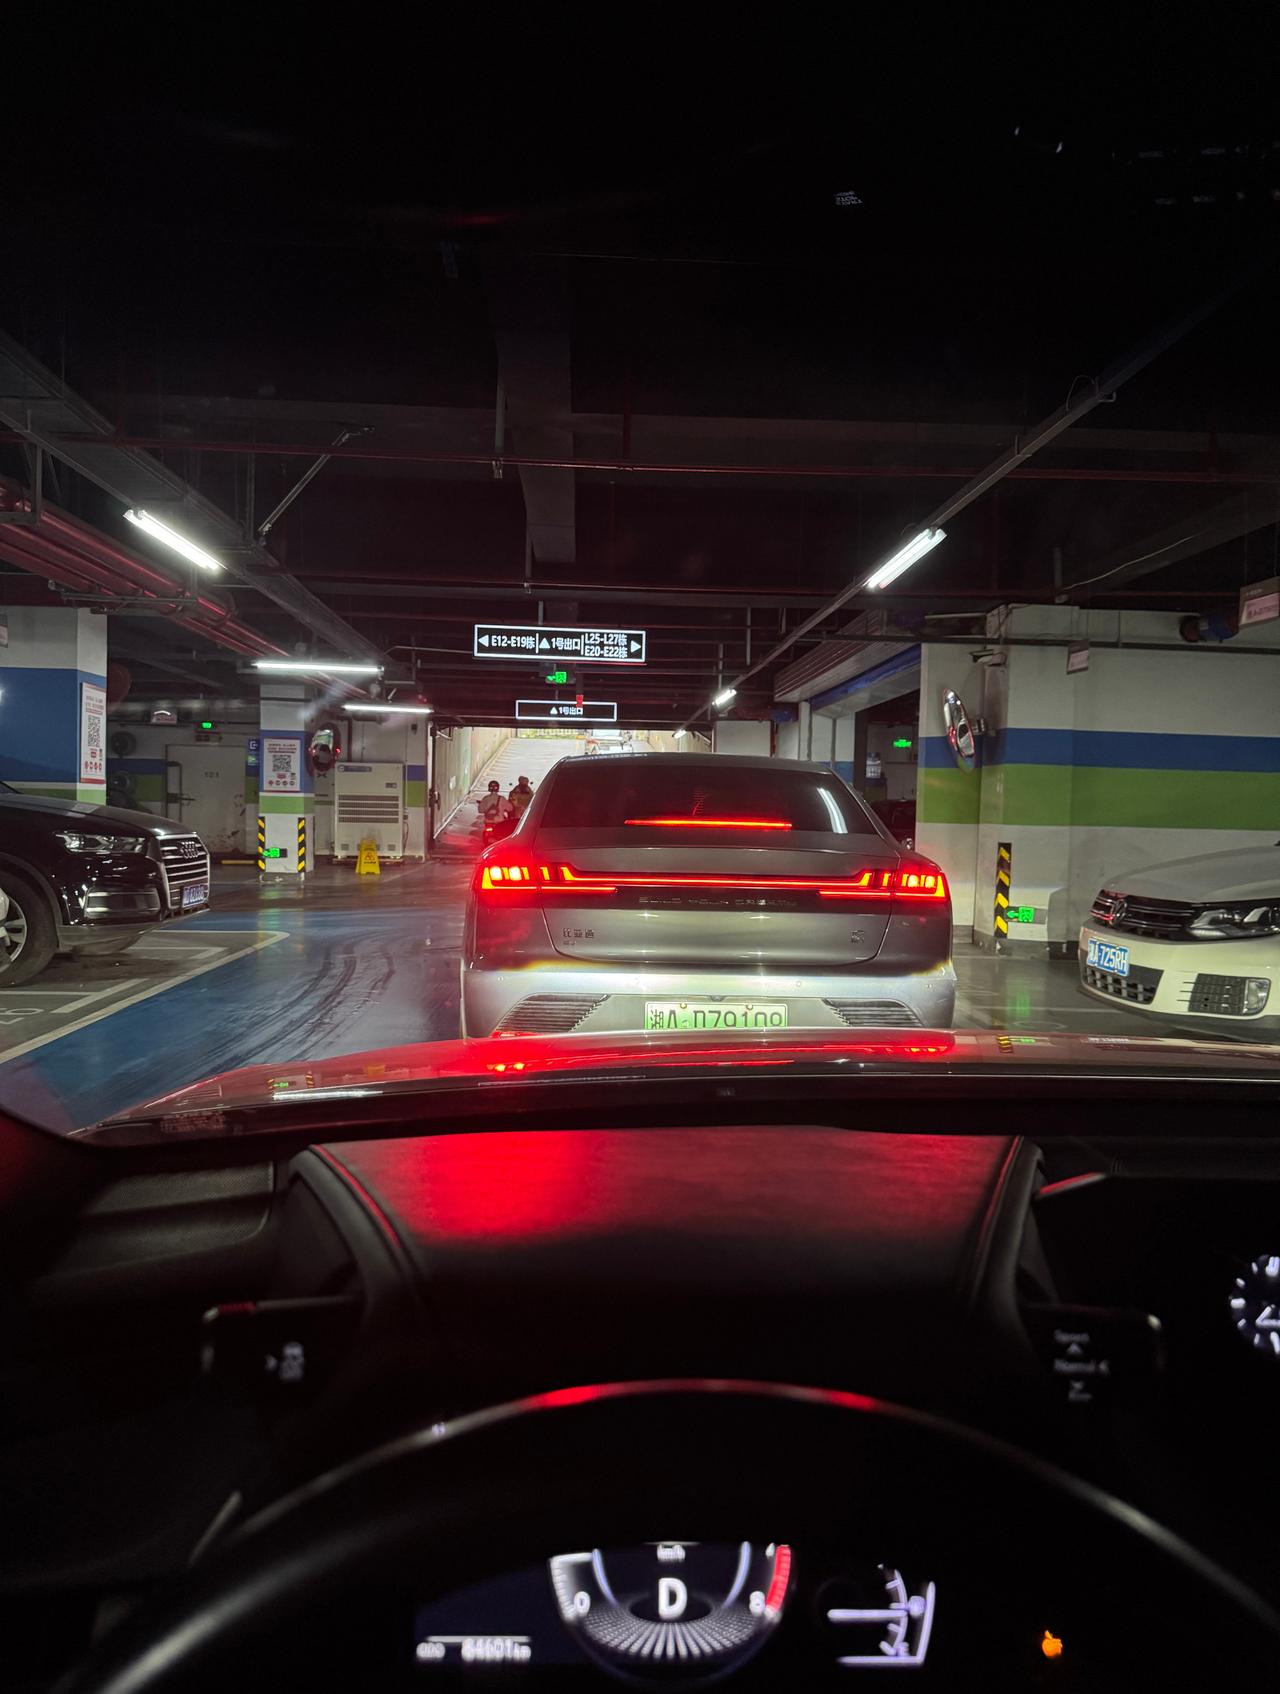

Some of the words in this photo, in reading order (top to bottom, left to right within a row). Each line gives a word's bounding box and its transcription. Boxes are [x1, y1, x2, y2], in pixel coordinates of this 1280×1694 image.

[551, 637, 581, 650] 1号出口
[658, 1577, 687, 1620] D
